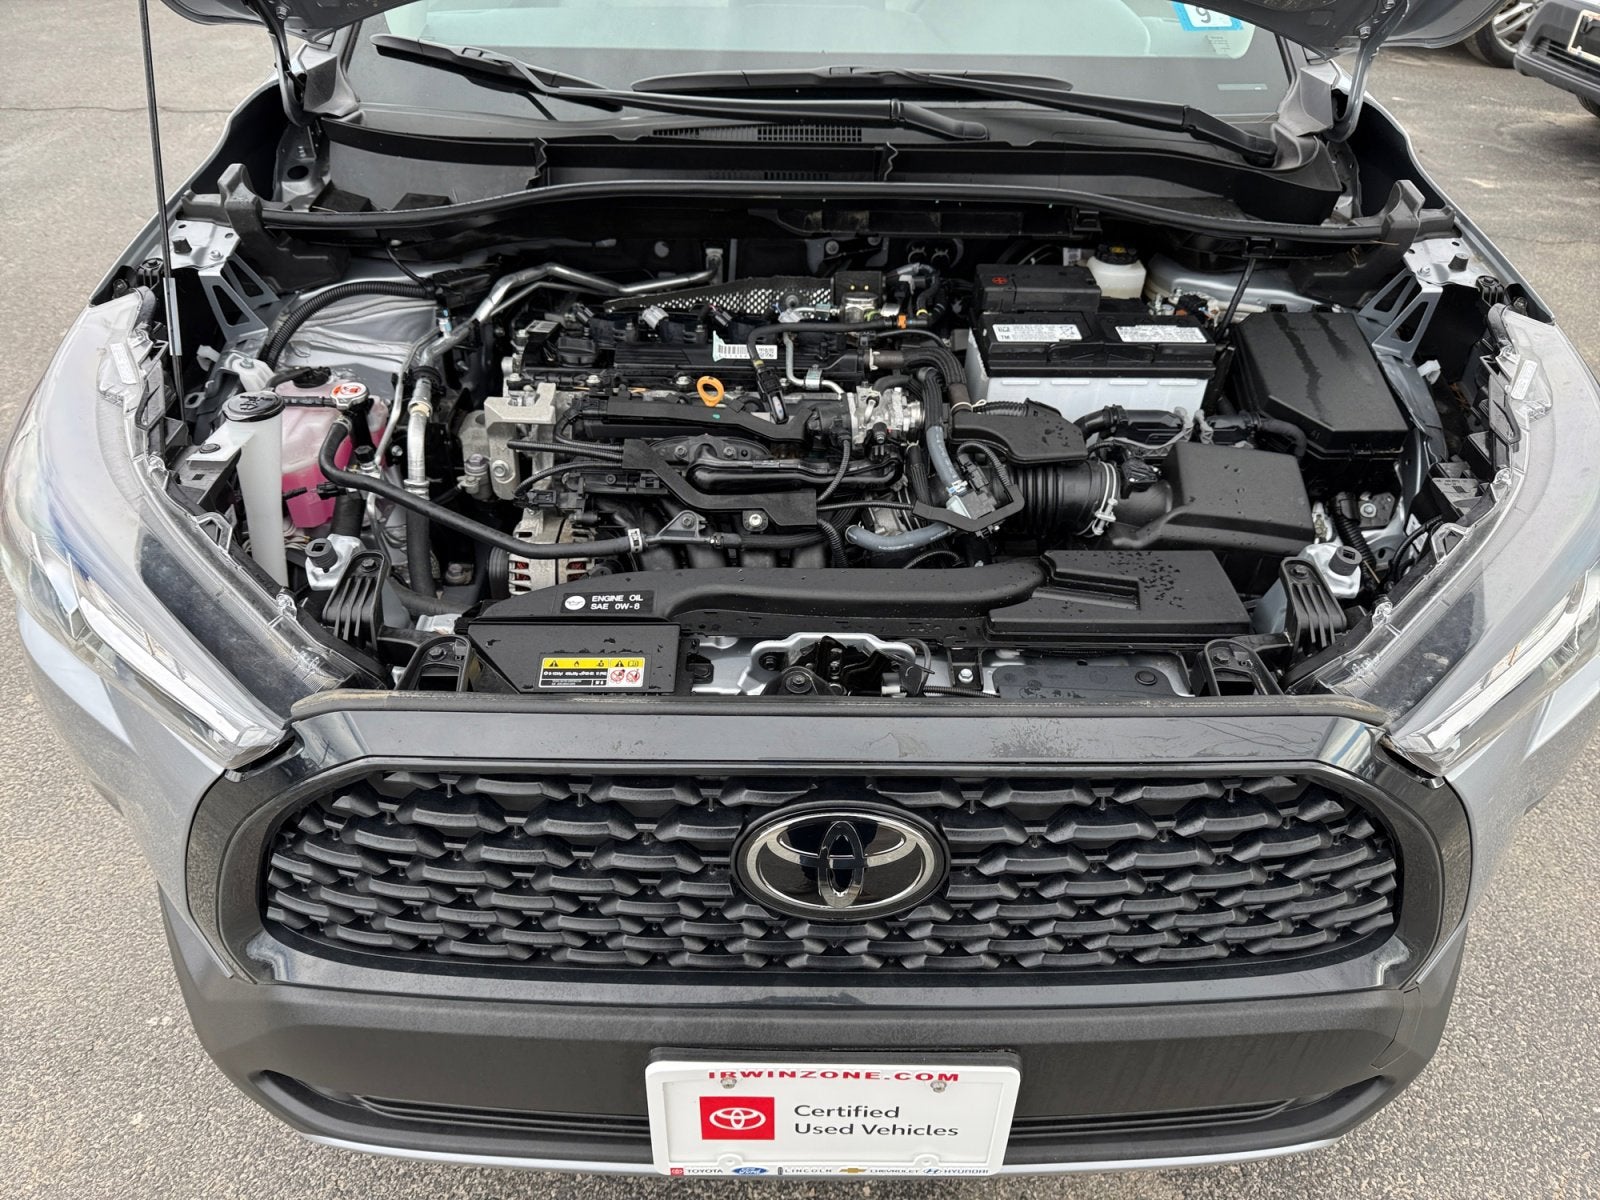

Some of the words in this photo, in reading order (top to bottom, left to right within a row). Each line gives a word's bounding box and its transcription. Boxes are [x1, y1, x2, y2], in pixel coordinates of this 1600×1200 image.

[708, 1070, 959, 1082] IRWINZONE.COM
[794, 1104, 900, 1119] Certified
[795, 1123, 854, 1136] Used
[861, 1123, 959, 1137] Vehicles
